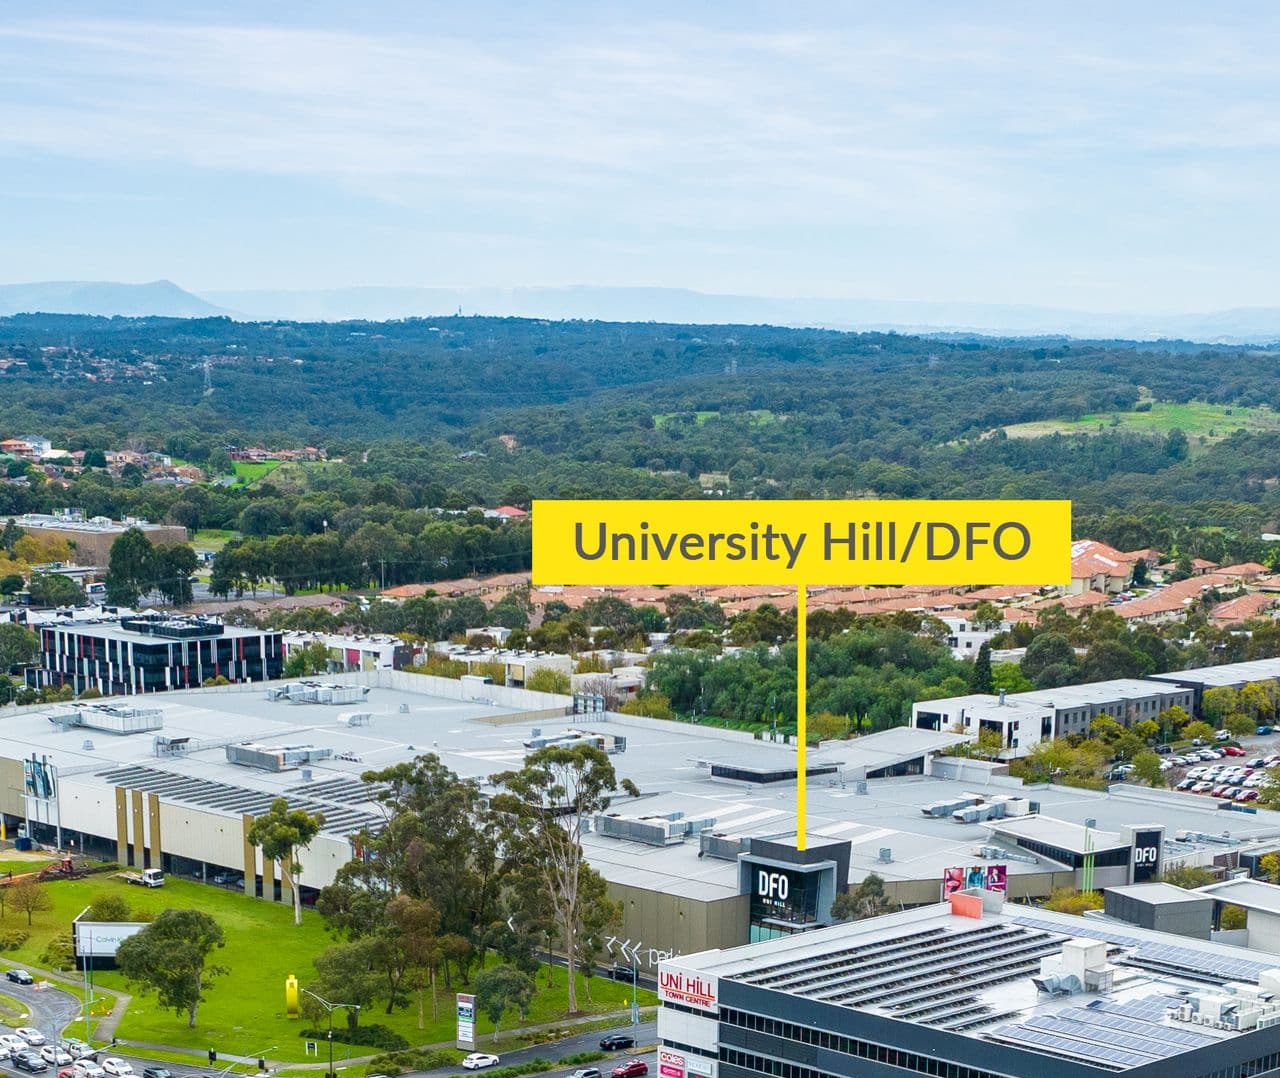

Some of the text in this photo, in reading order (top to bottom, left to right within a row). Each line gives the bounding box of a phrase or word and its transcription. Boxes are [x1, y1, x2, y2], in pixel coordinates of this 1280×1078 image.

[1135, 846, 1157, 863] DFO
[758, 869, 789, 900] DFO
[665, 990, 711, 1008] TOWN CENTRE
